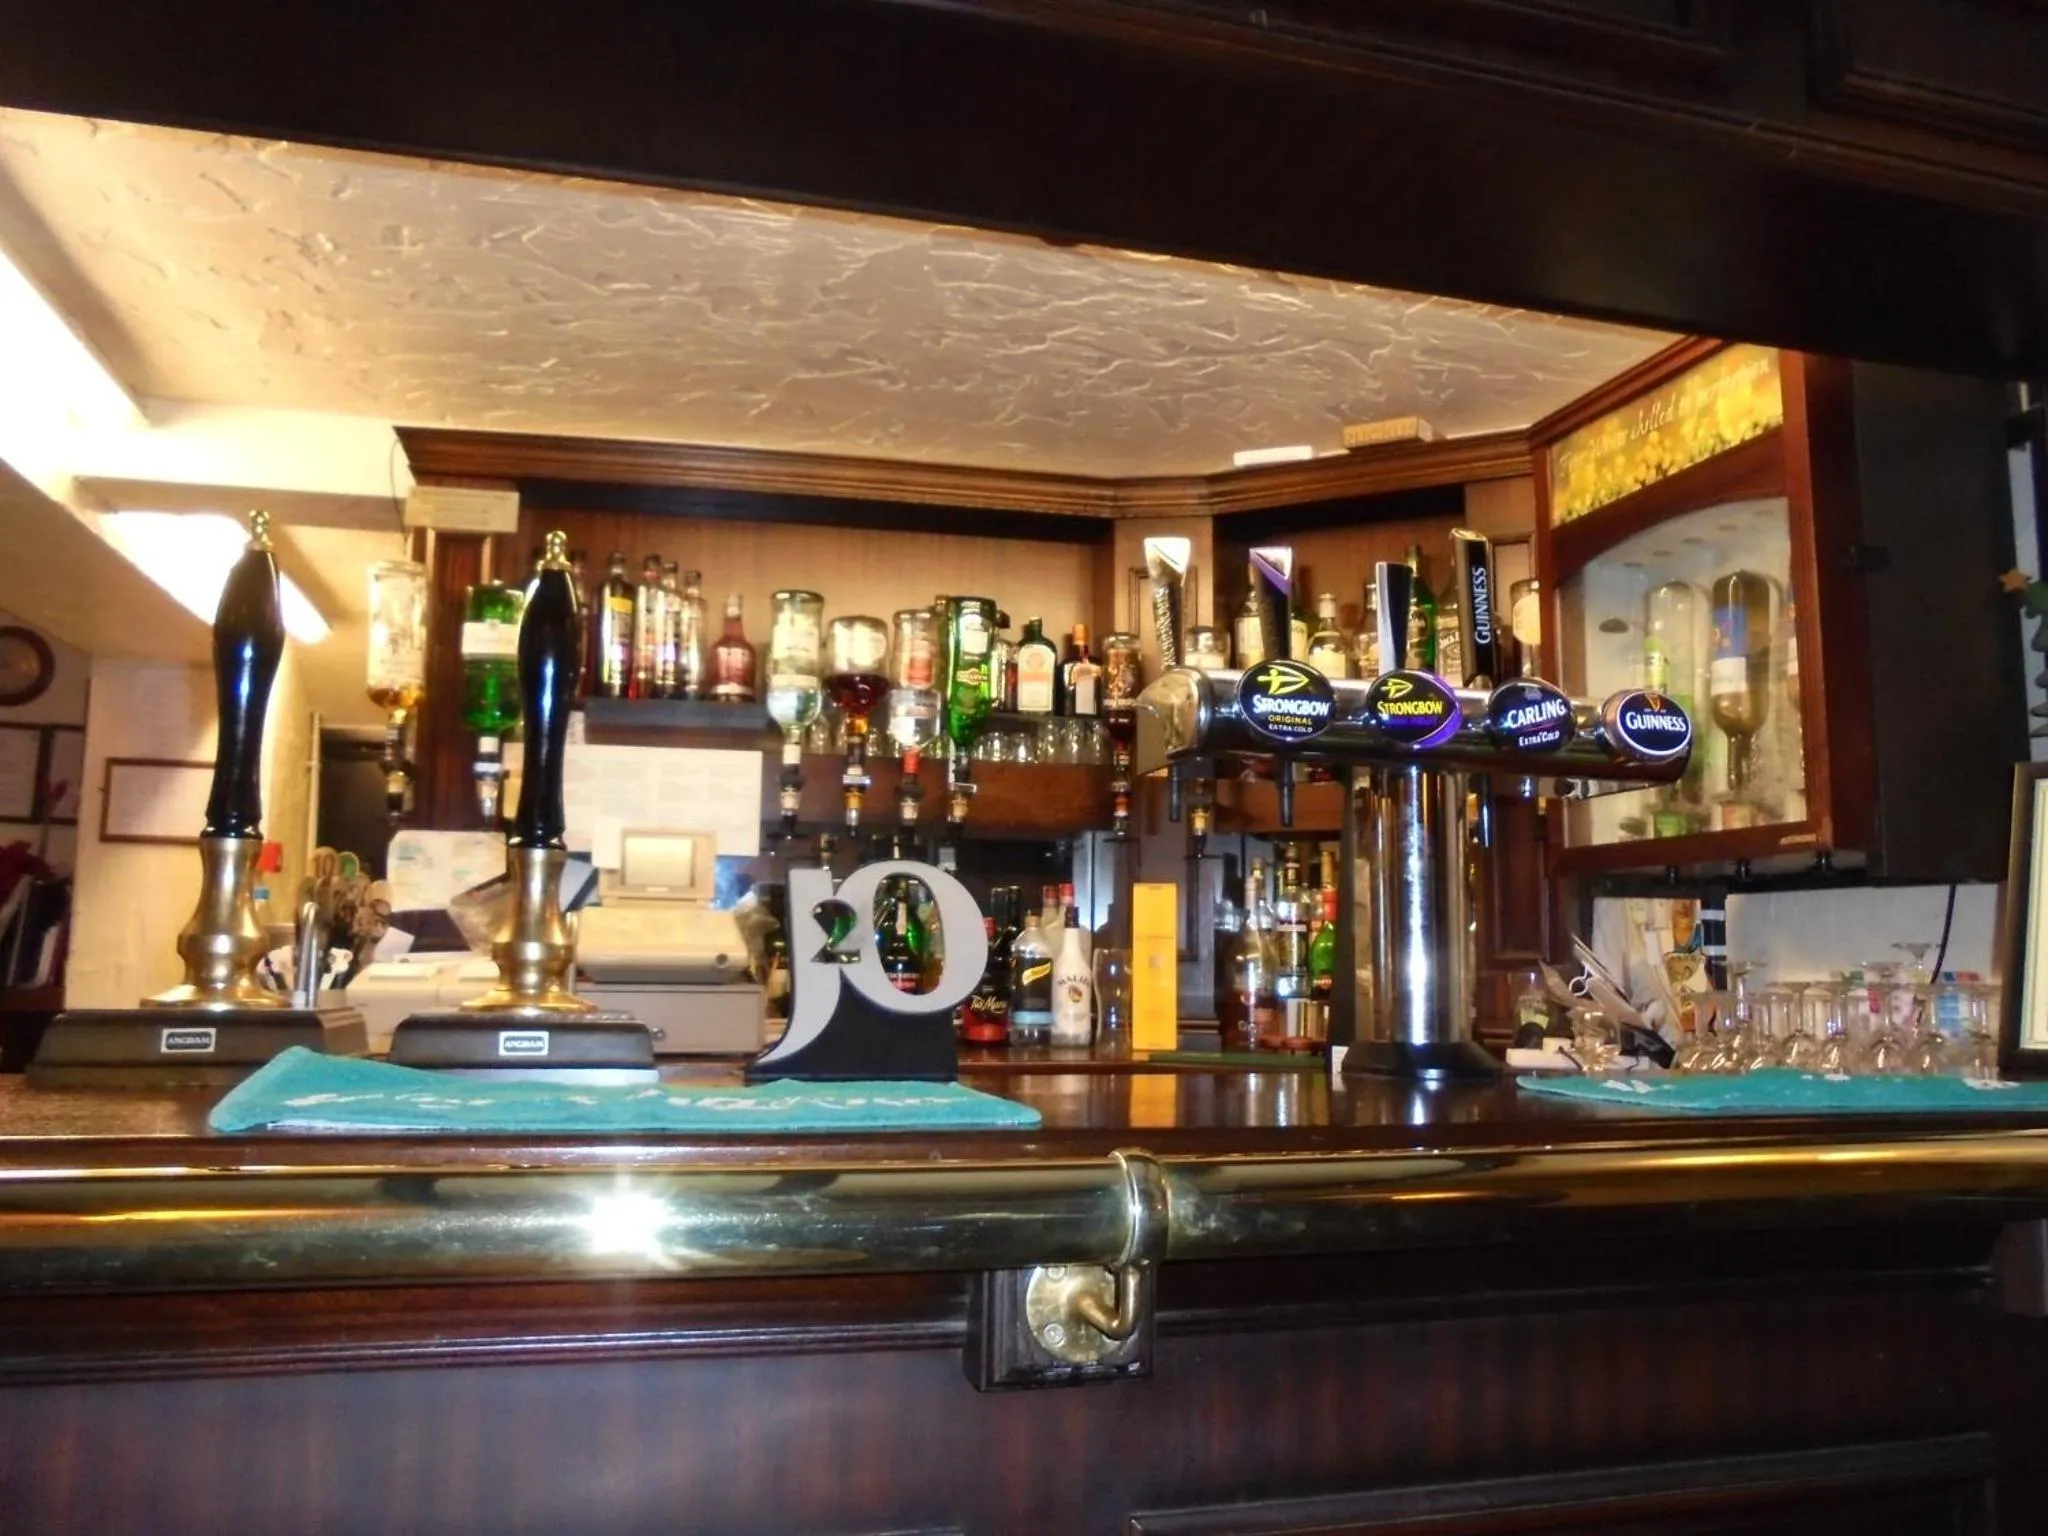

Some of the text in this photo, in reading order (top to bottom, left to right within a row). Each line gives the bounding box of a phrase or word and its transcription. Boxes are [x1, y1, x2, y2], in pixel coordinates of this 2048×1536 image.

[1472, 566, 1491, 644] GUINNESS
[1253, 695, 1331, 716] STRONGBOW
[1377, 700, 1443, 716] STRONGBOW
[1507, 699, 1566, 728] CARLING
[1268, 714, 1313, 725] ORIGINAL
[1293, 724, 1313, 733] COLD
[1626, 711, 1687, 732] GUINNESS
